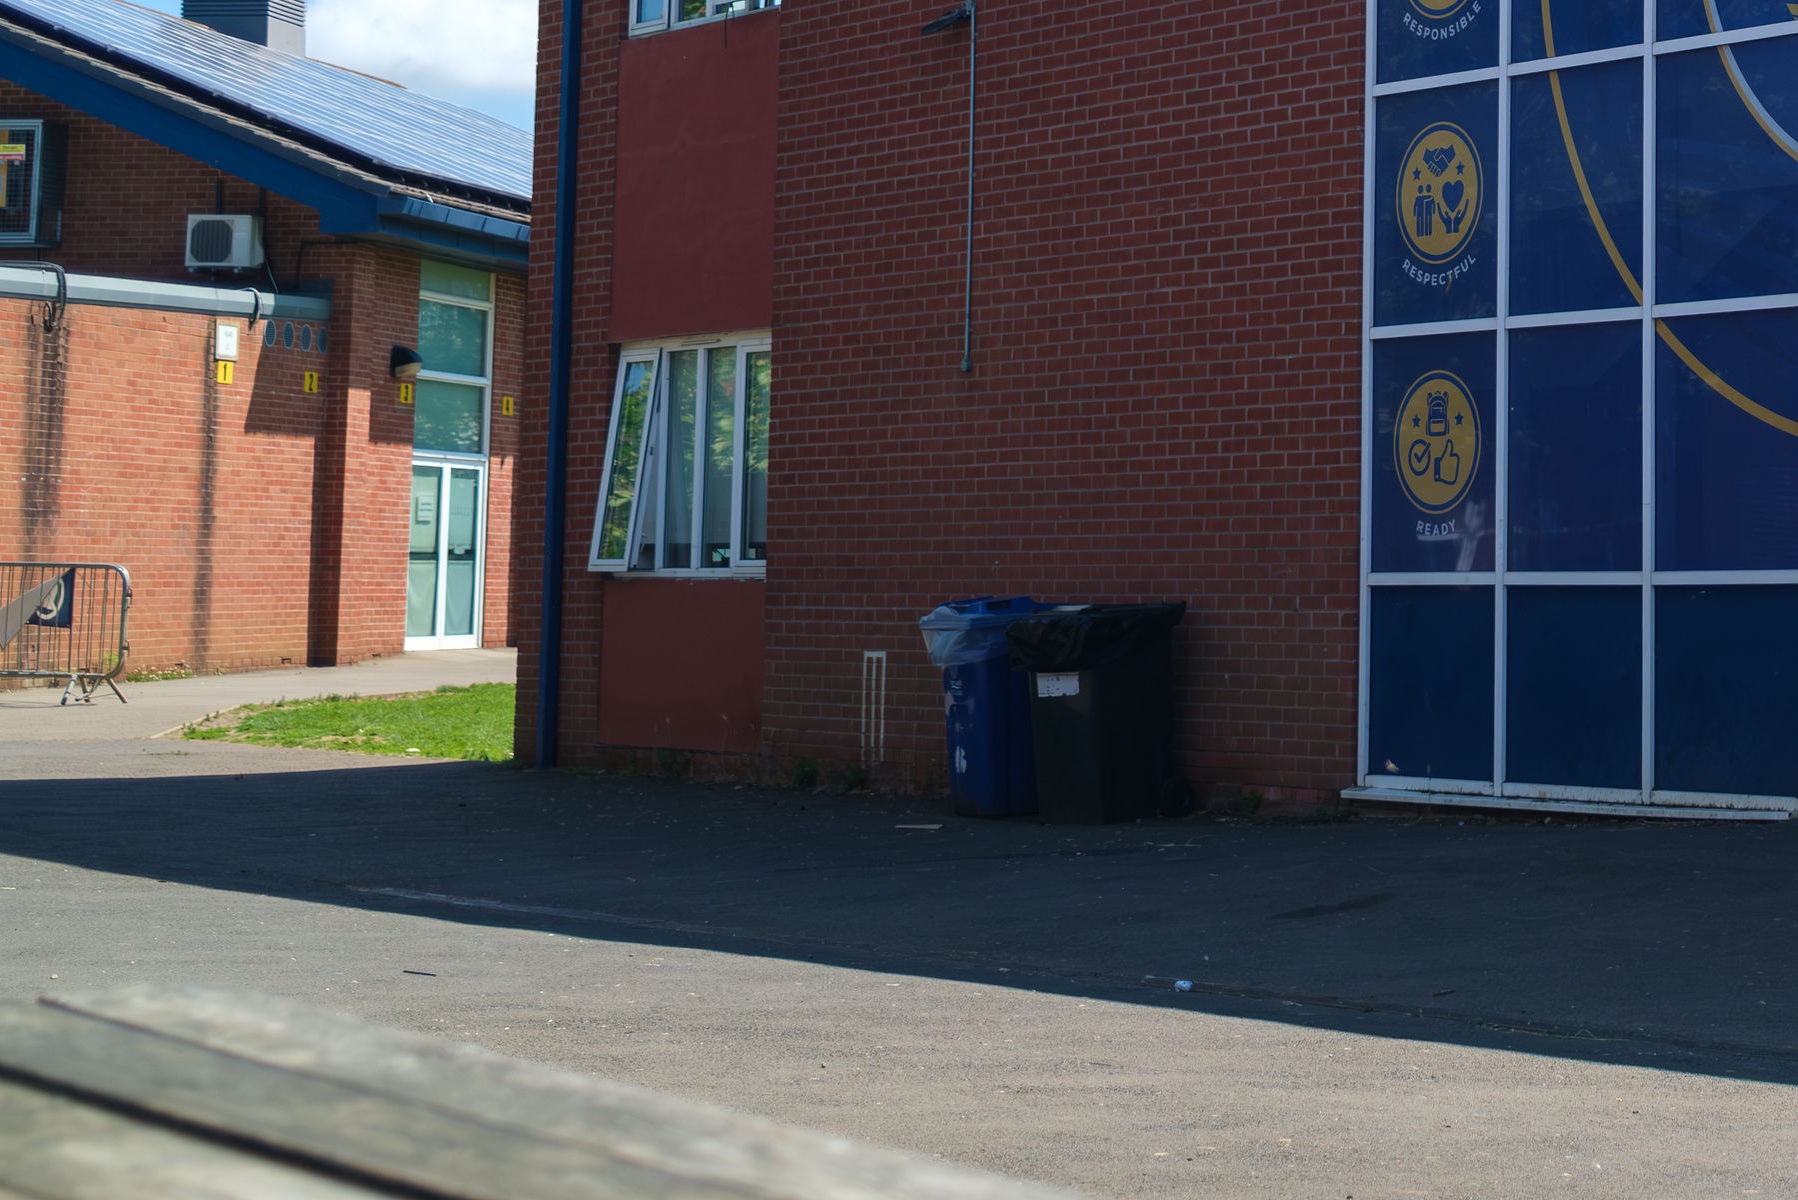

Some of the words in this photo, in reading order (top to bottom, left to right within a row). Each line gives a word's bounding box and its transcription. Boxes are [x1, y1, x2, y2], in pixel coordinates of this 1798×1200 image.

[1402, 0, 1481, 41] RESPONSIBLE
[1402, 254, 1477, 287] RESPECTFUL
[1416, 519, 1456, 536] READY
